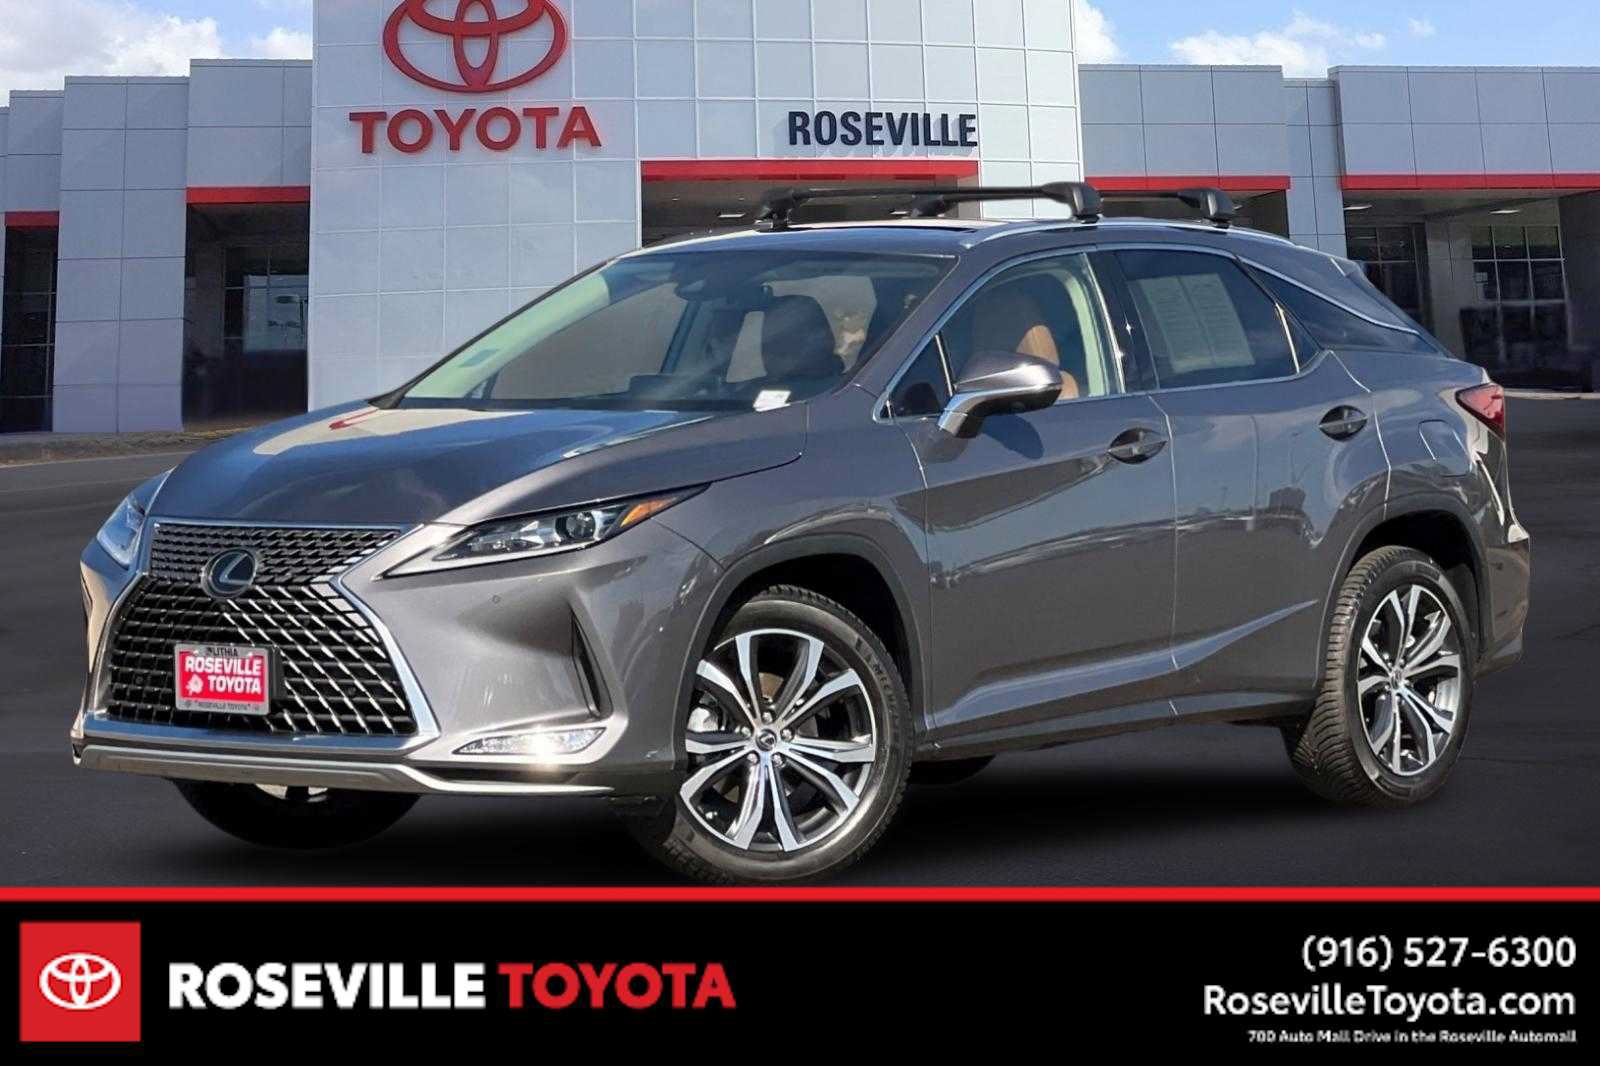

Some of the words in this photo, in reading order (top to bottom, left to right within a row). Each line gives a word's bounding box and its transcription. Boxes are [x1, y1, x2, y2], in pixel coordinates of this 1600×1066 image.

[349, 106, 602, 153] TOYOTA
[788, 111, 979, 147] ROSEVILLE
[185, 656, 262, 676] ROSEVILLE
[207, 675, 262, 694] TOYOTA
